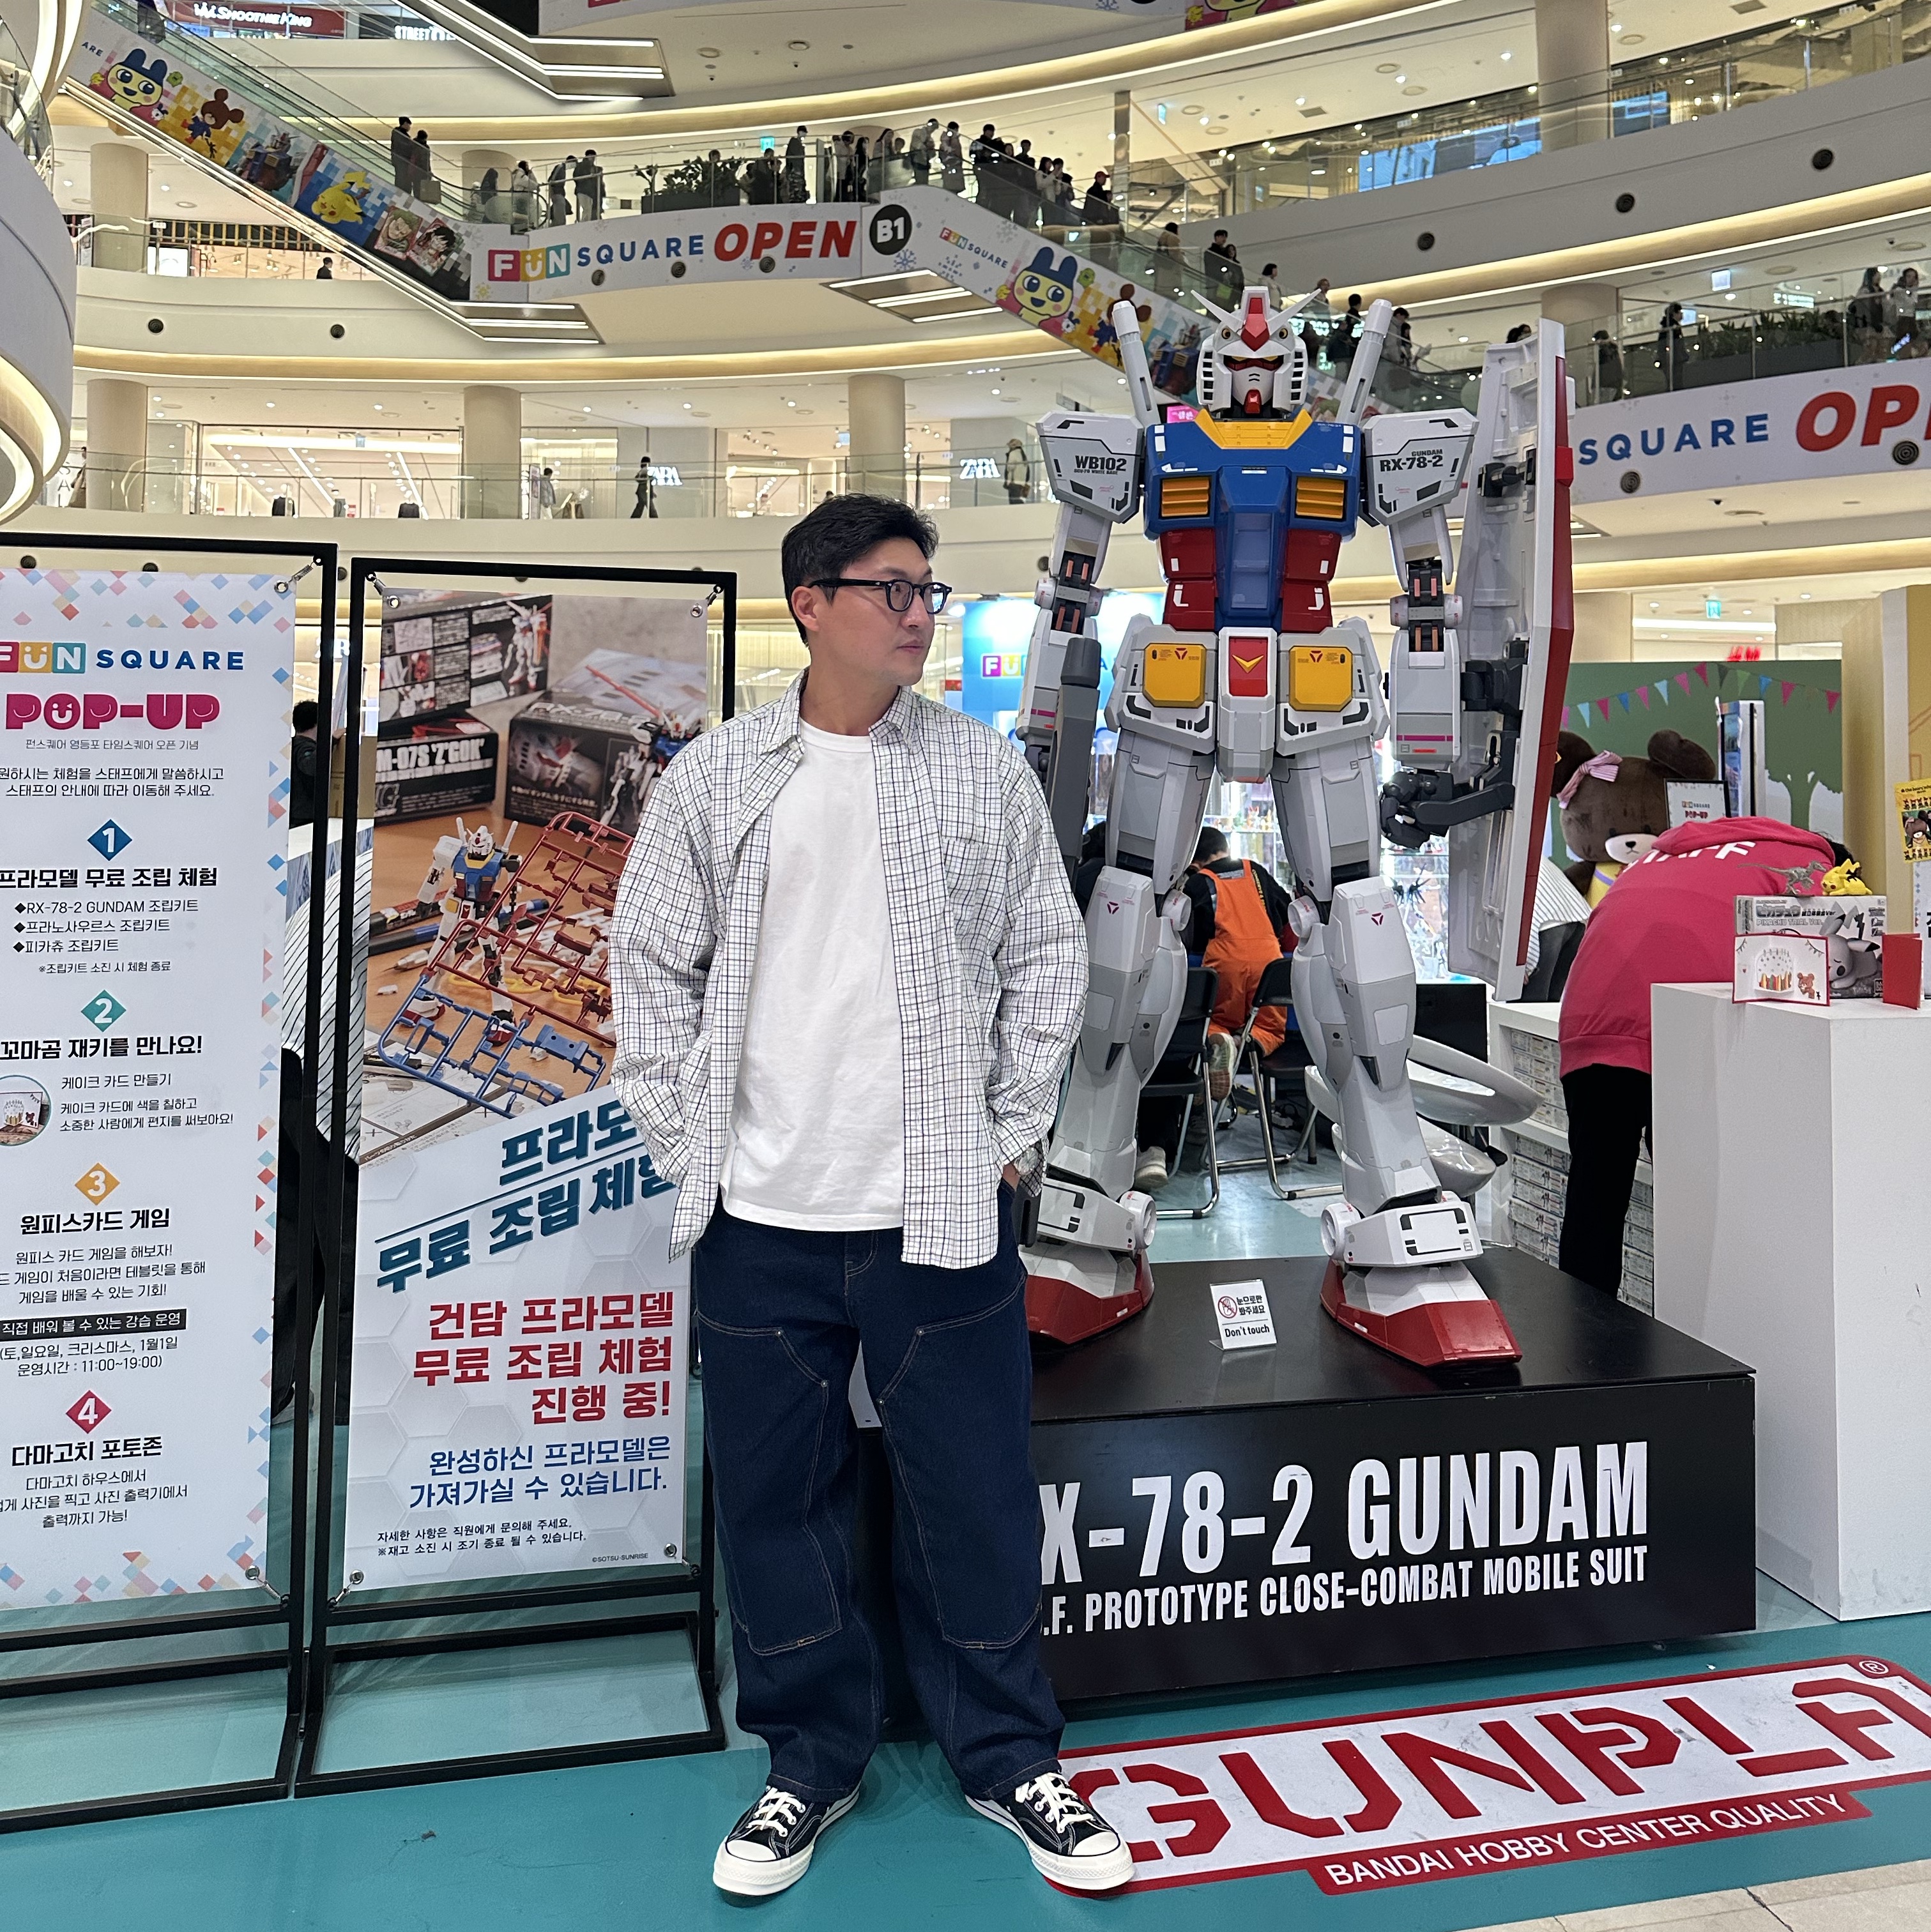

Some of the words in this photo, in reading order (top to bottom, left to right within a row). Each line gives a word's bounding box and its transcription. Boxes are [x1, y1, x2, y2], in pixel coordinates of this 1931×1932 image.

[217, 6, 280, 25] SMOOTHIE
[280, 12, 312, 27] KING
[81, 42, 104, 57] ARE
[876, 217, 906, 244] B1
[491, 246, 569, 280] FUN
[577, 234, 703, 266] SQUARE
[714, 220, 857, 262] OPEN
[940, 227, 968, 249] FUN
[967, 243, 1009, 269] SQUARE
[1579, 414, 1769, 465] SQUARE
[1796, 384, 1931, 452] OP
[1075, 455, 1127, 471] WB102
[1380, 455, 1444, 472] RX-78-2
[1412, 448, 1443, 457] GUNDAM
[960, 458, 1001, 480] ZARA
[96, 650, 243, 670] SQUARE
[6, 694, 220, 730] POP-UP
[26, 740, 66, 749] 펀스퀘어
[70, 740, 100, 750] 영등포
[103, 740, 153, 750] 타임스퀘어
[156, 740, 176, 750] 오픈
[179, 740, 199, 750] 기념
[53, 768, 91, 780] 체험을
[95, 768, 158, 780] 스태프에게
[162, 768, 224, 780] 말씀하시고
[6, 784, 57, 796] 스태프의
[61, 784, 99, 796] 안내에
[103, 784, 128, 796] 따라
[133, 784, 170, 796] 이동해
[174, 784, 214, 796] 주세요.
[102, 828, 114, 853] 1
[0, 869, 78, 888] 프라모델
[85, 869, 125, 888] 무료
[132, 868, 171, 886] 조립
[178, 867, 217, 886] 체험
[86, 901, 144, 913] GUNDAM
[148, 900, 198, 912] 조립키트
[26, 920, 116, 933] 프라노사우르스
[119, 919, 170, 932] 조립키트
[25, 940, 63, 953] 피카츄
[68, 939, 118, 952] 조립키트
[91, 962, 111, 973] 소진
[114, 962, 124, 972] 시
[127, 962, 148, 971] 체험
[151, 961, 171, 971] 종료
[95, 998, 112, 1023] 2
[0, 1040, 61, 1060] 꼬마곰
[68, 1038, 129, 1058] 재키를
[137, 1035, 202, 1056] 만나요!
[61, 1076, 100, 1090] 케이크
[104, 1075, 129, 1088] 카드
[134, 1073, 171, 1086] 만들기
[61, 1102, 95, 1114] 케이크
[99, 1100, 133, 1113] 카드에
[137, 1100, 159, 1111] 색을
[164, 1098, 197, 1110] 칠하고
[60, 1120, 95, 1132] 소중한
[98, 1117, 144, 1130] 사람에게
[148, 1116, 181, 1128] 편지를
[185, 1113, 233, 1126] 써보아요!
[88, 1171, 105, 1196] 3
[20, 1211, 123, 1235] 원피스카드
[130, 1208, 169, 1229] 게임
[377, 1220, 471, 1293] 무료
[489, 1178, 580, 1255] 조립
[16, 1251, 54, 1265] 원피스
[59, 1249, 84, 1262] 카드
[88, 1247, 126, 1261] 게임을
[131, 1244, 172, 1258] 해보자!
[14, 1270, 52, 1284] 게임이
[57, 1266, 121, 1282] 처음이라면
[126, 1263, 176, 1278] 테블릿을
[181, 1261, 205, 1275] 통해
[19, 1290, 57, 1304] 게임을
[62, 1289, 88, 1302] 배울
[91, 1288, 104, 1300] 수
[109, 1286, 134, 1299] 있는
[138, 1284, 166, 1297] 기회!
[2, 1321, 28, 1335] 직접
[33, 1320, 58, 1334] 배워
[62, 1318, 76, 1332] 볼
[79, 1318, 93, 1331] 수
[96, 1316, 122, 1330] 있는
[125, 1314, 151, 1329] 강습
[154, 1312, 180, 1327] 운영
[429, 1301, 507, 1341] 건담
[521, 1291, 673, 1334] 프라모델
[1225, 1326, 1247, 1337] Don't
[1248, 1324, 1270, 1335] touch
[68, 1340, 135, 1356] 크리스마스,
[141, 1336, 178, 1351] 1월1일
[18, 1361, 70, 1377] 운영시간
[82, 1355, 162, 1372] 11:00~19:00)
[413, 1348, 489, 1387] 무료
[507, 1341, 581, 1380] 조립
[599, 1336, 671, 1374] 체험
[78, 1398, 98, 1424] 4
[532, 1385, 606, 1425] 진행
[623, 1381, 670, 1419] 중!
[12, 1441, 94, 1466] 다마고치
[101, 1436, 162, 1459] 포토존
[429, 1445, 533, 1476] 완성하신
[544, 1436, 670, 1467] 프라모델은
[26, 1474, 77, 1491] 다마고치
[82, 1469, 146, 1486] 하우스에서
[410, 1477, 513, 1508] 가져가실
[525, 1476, 549, 1500] 수
[561, 1467, 666, 1498] 있습니다.
[21, 1495, 60, 1510] 사진을
[65, 1493, 90, 1506] 찍고
[94, 1490, 119, 1504] 사진
[124, 1484, 187, 1502] 출력기에서
[43, 1512, 94, 1528] 출력까지
[98, 1509, 127, 1523] 가능!
[1039, 1464, 1312, 1585] X-78-2
[1349, 1441, 1648, 1561] GUNDAM
[378, 1530, 410, 1542] 자세한
[415, 1527, 448, 1539] 사항은
[453, 1523, 495, 1537] 직원에게
[500, 1521, 531, 1533] 문의해
[537, 1518, 572, 1530] 주세요.
[415, 1542, 436, 1553] 소진
[441, 1541, 452, 1552] 시
[457, 1539, 478, 1550] 조기
[484, 1538, 505, 1549] 종료
[526, 1535, 536, 1545] 수
[542, 1530, 586, 1544] 있습니다.
[1086, 1581, 1249, 1632] PROTOTYPE
[1260, 1560, 1473, 1616] CLOSE-COMBAT
[1483, 1551, 1579, 1595] MOBILE
[1590, 1546, 1647, 1585] SUIT
[1324, 1843, 1455, 1887] BANDAI
[1456, 1830, 1571, 1869] HOBBY
[1576, 1811, 1707, 1852] CENTER
[1710, 1793, 1847, 1832] QUALITY
